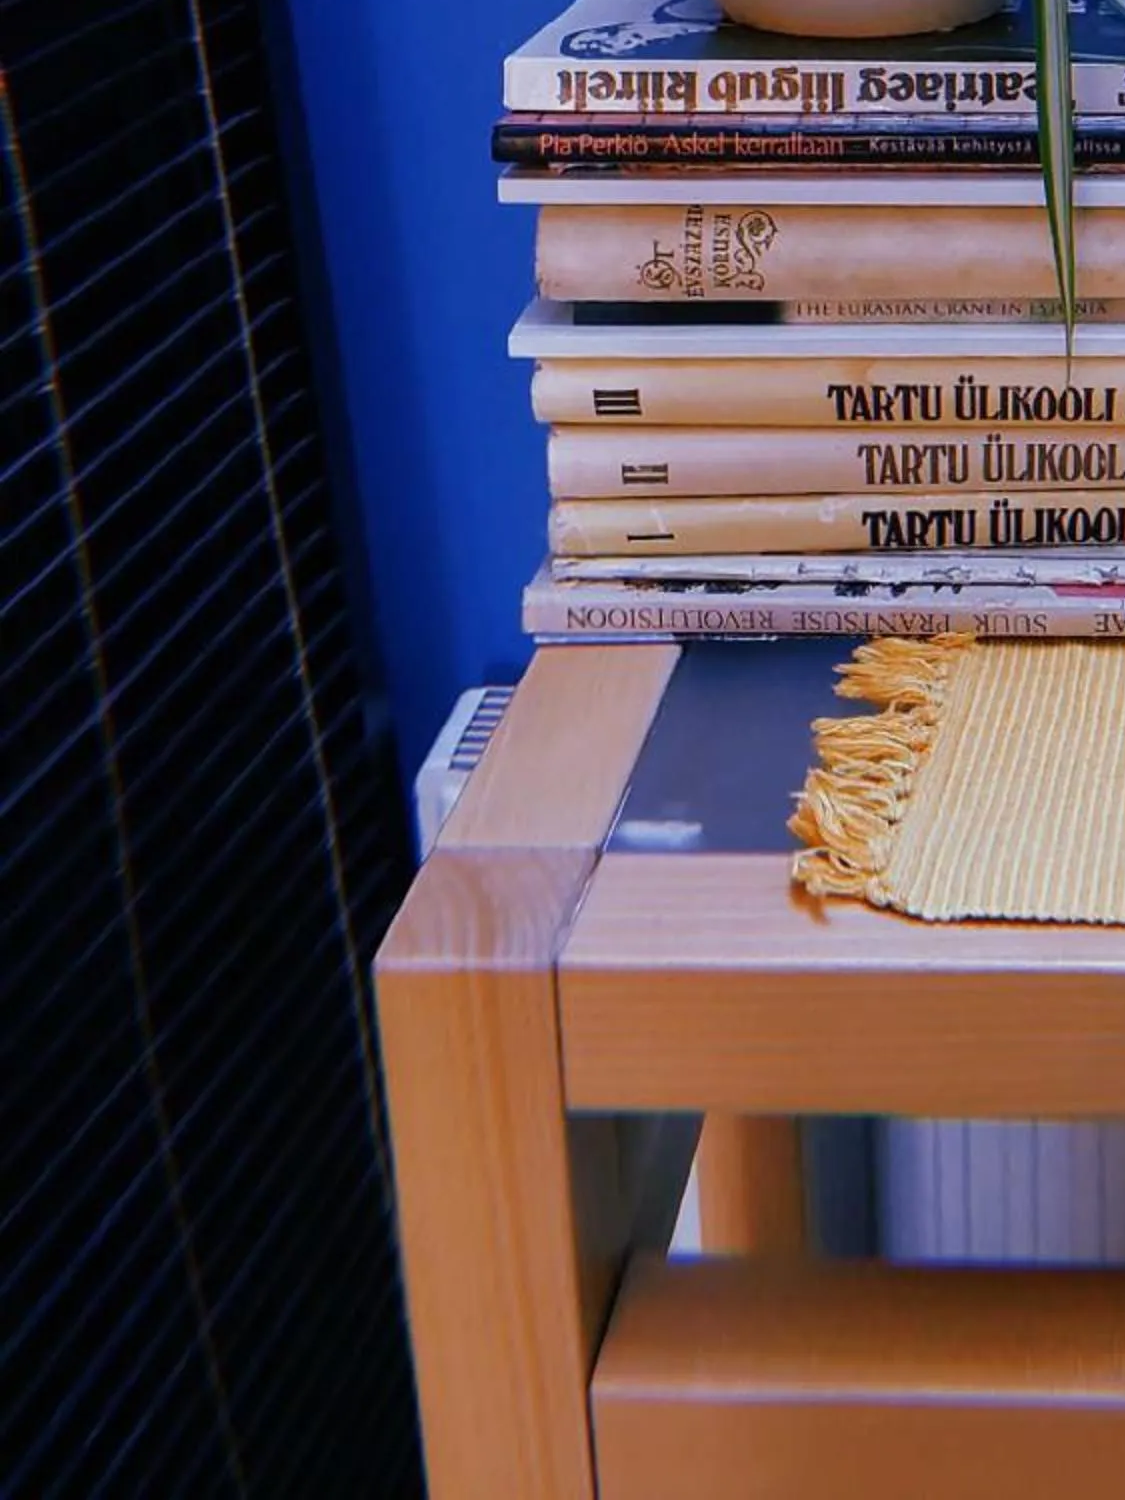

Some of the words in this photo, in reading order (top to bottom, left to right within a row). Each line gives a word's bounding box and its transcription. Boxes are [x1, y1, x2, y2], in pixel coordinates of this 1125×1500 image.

[556, 70, 698, 111] kiirelt
[707, 67, 846, 112] liigub
[858, 67, 1076, 112] eatriaeg
[539, 132, 572, 156] Pia
[578, 132, 649, 156] Perkiö
[662, 131, 726, 156] Askel
[734, 131, 845, 156] kerrallaan
[953, 135, 1032, 156] kehitystä
[796, 300, 830, 316] THE
[837, 301, 928, 316] EURASIAN
[933, 301, 994, 316] CRANE
[1001, 301, 1022, 315] IN
[592, 388, 643, 416] III
[827, 384, 944, 423] TARTU
[953, 375, 1117, 423] ÜLIKOOLI
[621, 463, 669, 485] II
[857, 442, 971, 485] TARTU
[862, 509, 976, 547] TARTU
[566, 605, 775, 632] REVOLUTSIOON
[792, 609, 951, 635] PRANTSUSE
[973, 612, 1048, 634] SUUR
